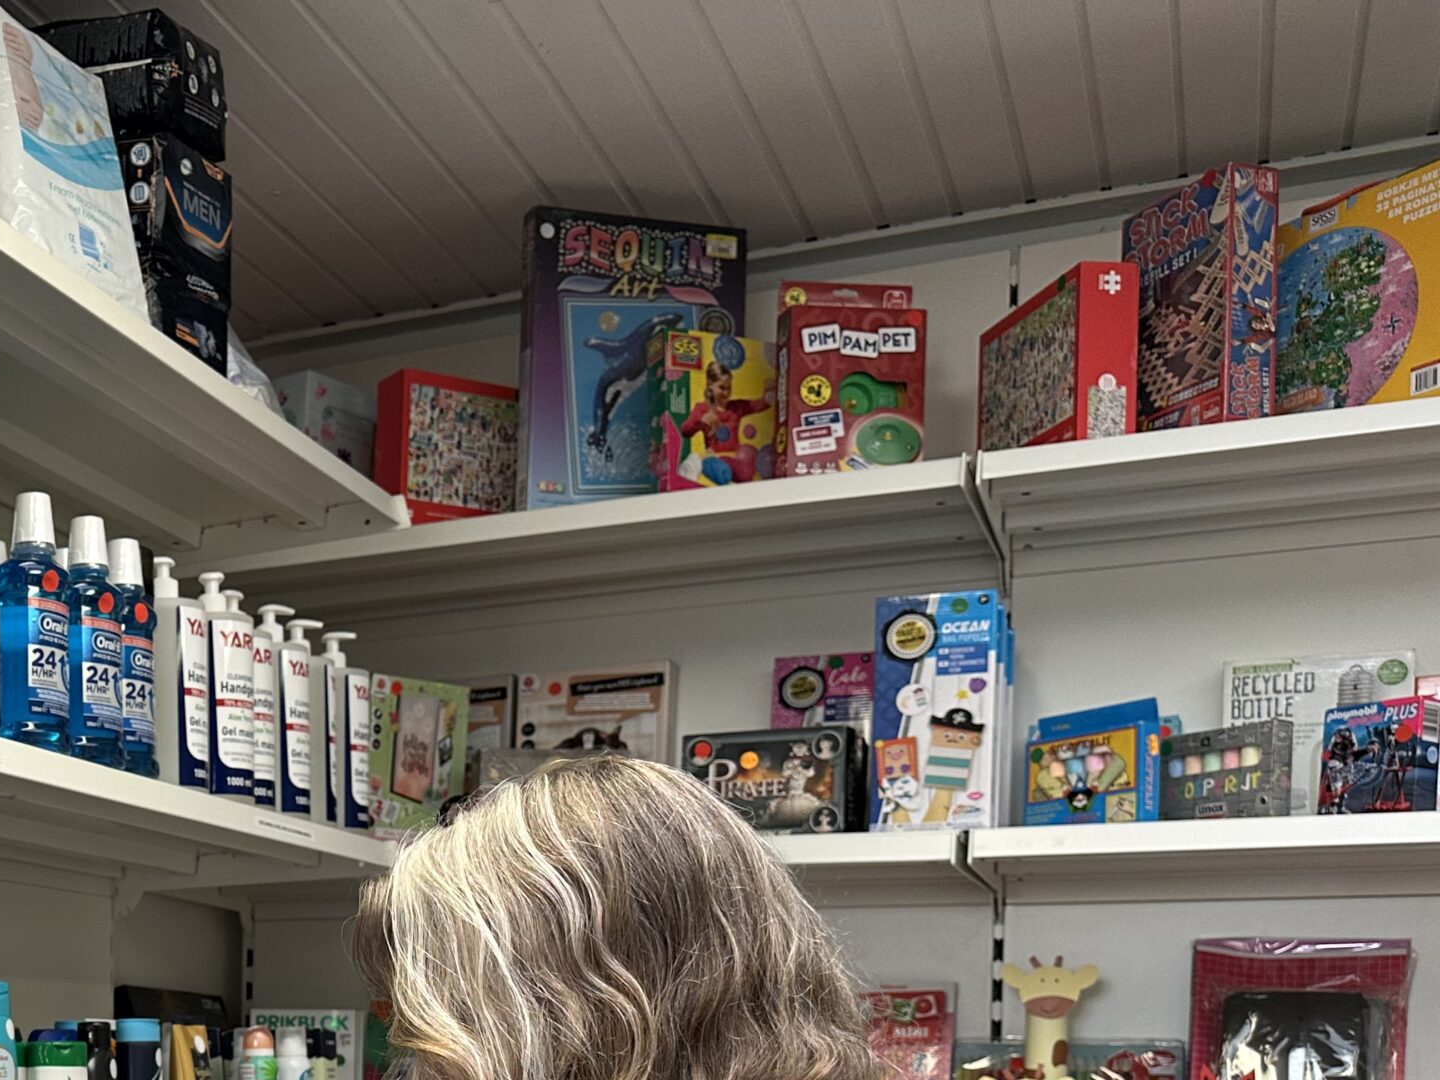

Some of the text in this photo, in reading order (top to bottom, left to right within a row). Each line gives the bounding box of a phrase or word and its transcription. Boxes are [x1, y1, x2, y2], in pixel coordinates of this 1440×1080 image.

[1377, 176, 1419, 202] BOEKJE
[182, 188, 222, 231] MEN
[1128, 184, 1200, 247] STICK
[1311, 210, 1336, 226] SASSI
[1388, 207, 1402, 219] EN
[1125, 209, 1210, 268] STORM
[564, 225, 715, 282] SEQUIN
[1174, 253, 1193, 270] SET
[610, 275, 663, 300] Art
[673, 339, 699, 355] SES
[808, 331, 837, 347] PIM
[843, 335, 877, 352] PAM
[883, 332, 911, 347] PET
[1230, 362, 1246, 415] STICK
[1246, 355, 1261, 419] STORM
[941, 619, 991, 634] OCEAN
[32, 648, 57, 669] 24
[86, 665, 110, 685] 24
[1231, 672, 1315, 698] RECYCLED
[125, 682, 147, 701] 24
[1231, 696, 1294, 720] BOTTLE
[1326, 704, 1378, 723] playmobil
[1384, 702, 1419, 722] PLUS
[227, 776, 244, 788] 1000
[706, 757, 788, 801] PIRATE
[255, 1015, 349, 1031] PRIKBLOK
